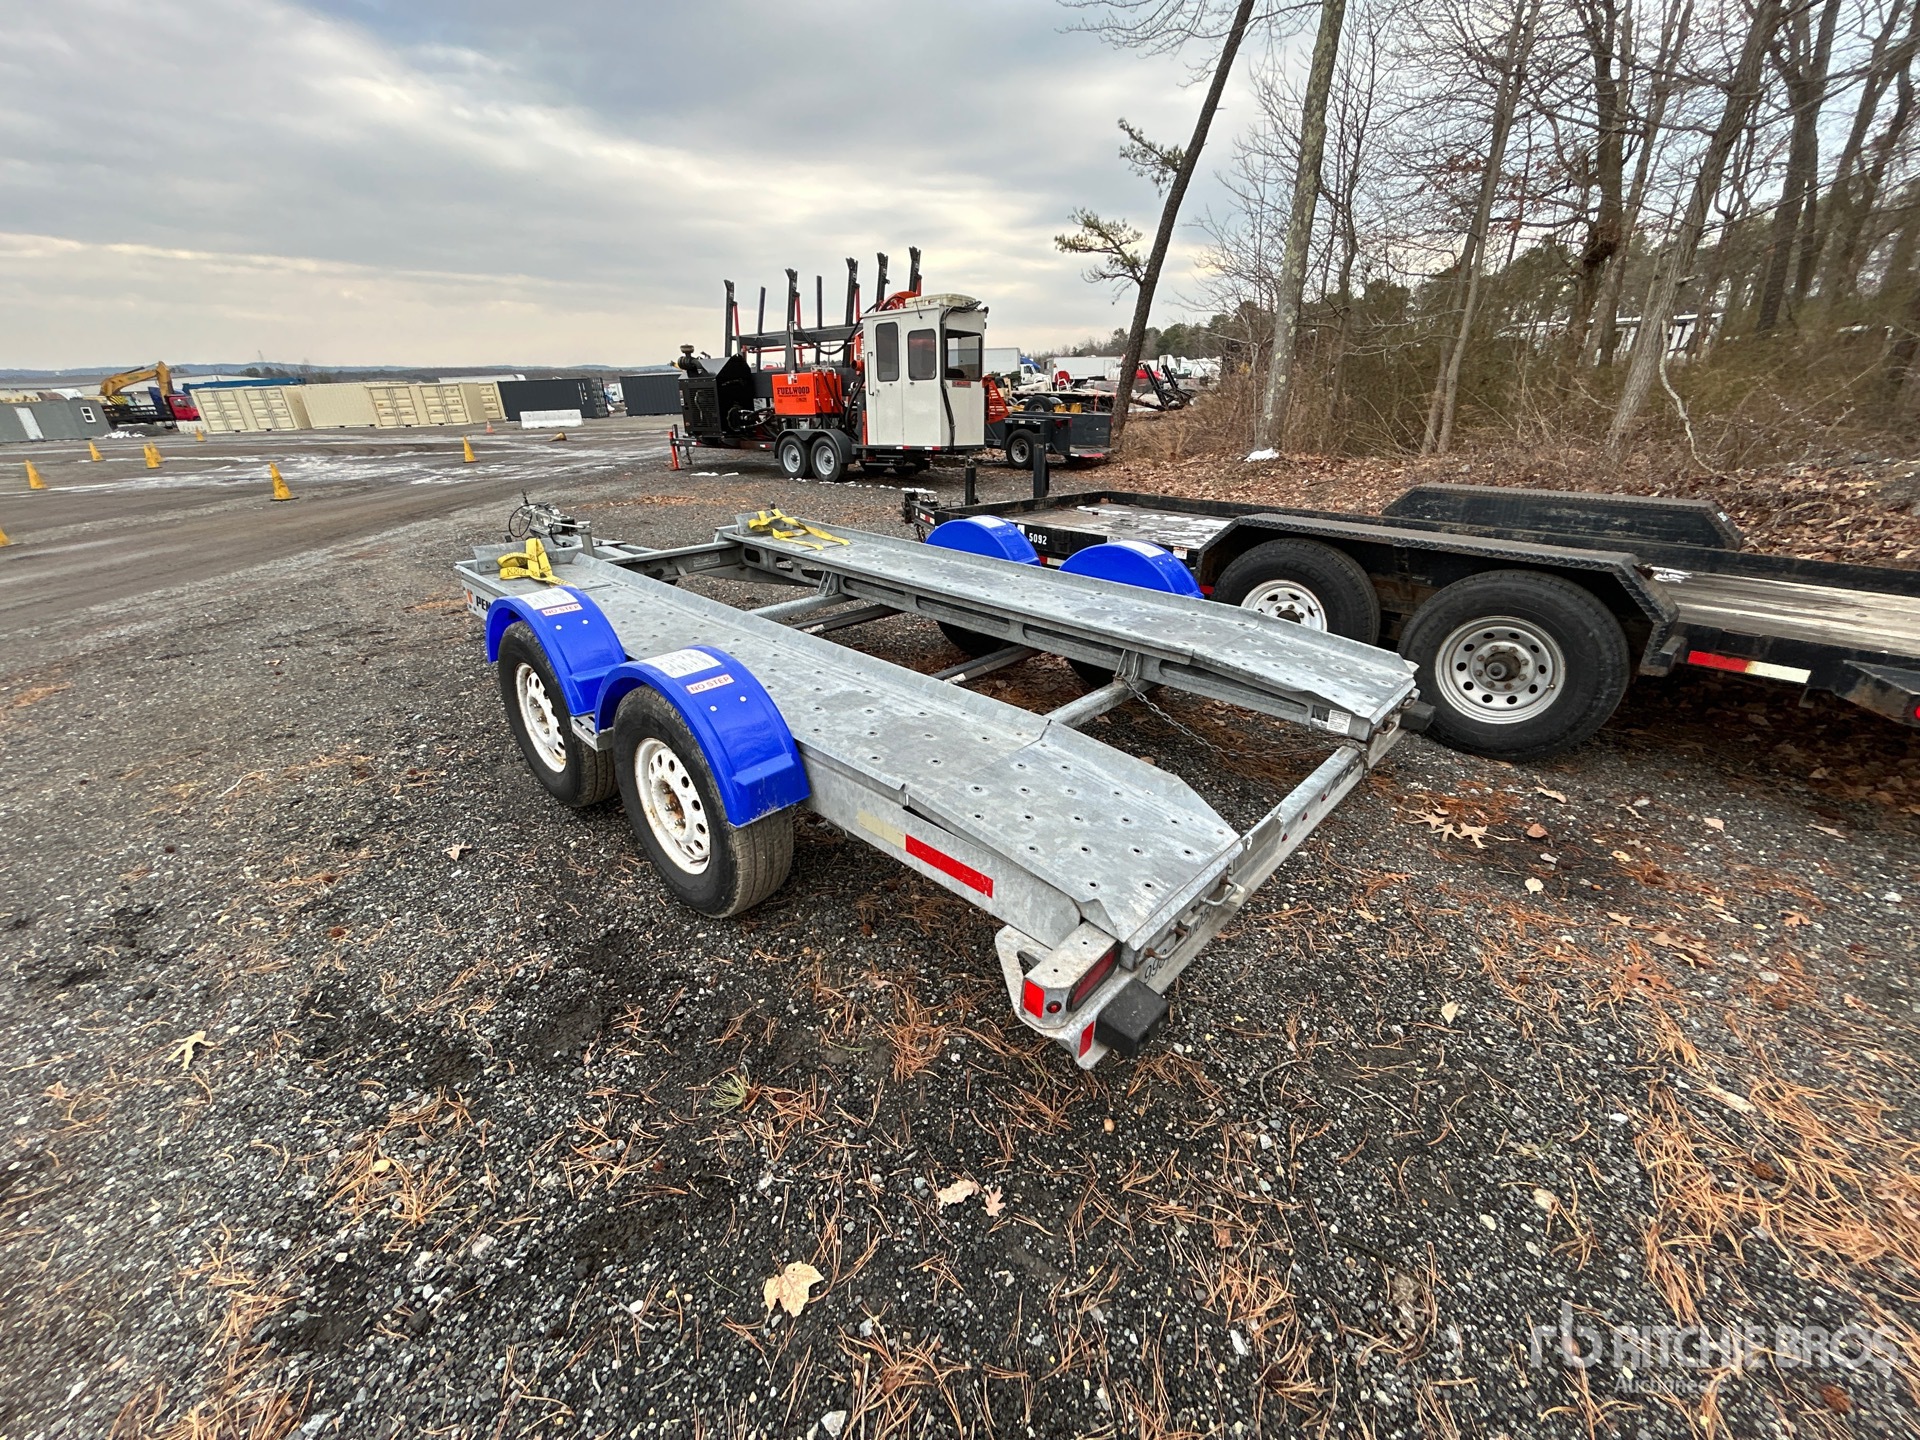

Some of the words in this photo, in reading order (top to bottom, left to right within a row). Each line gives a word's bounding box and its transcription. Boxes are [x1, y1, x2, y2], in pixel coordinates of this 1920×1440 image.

[777, 386, 809, 394] FUELWOOD
[1028, 532, 1047, 545] 5092
[690, 683, 705, 691] NO
[706, 676, 729, 687] STEP
